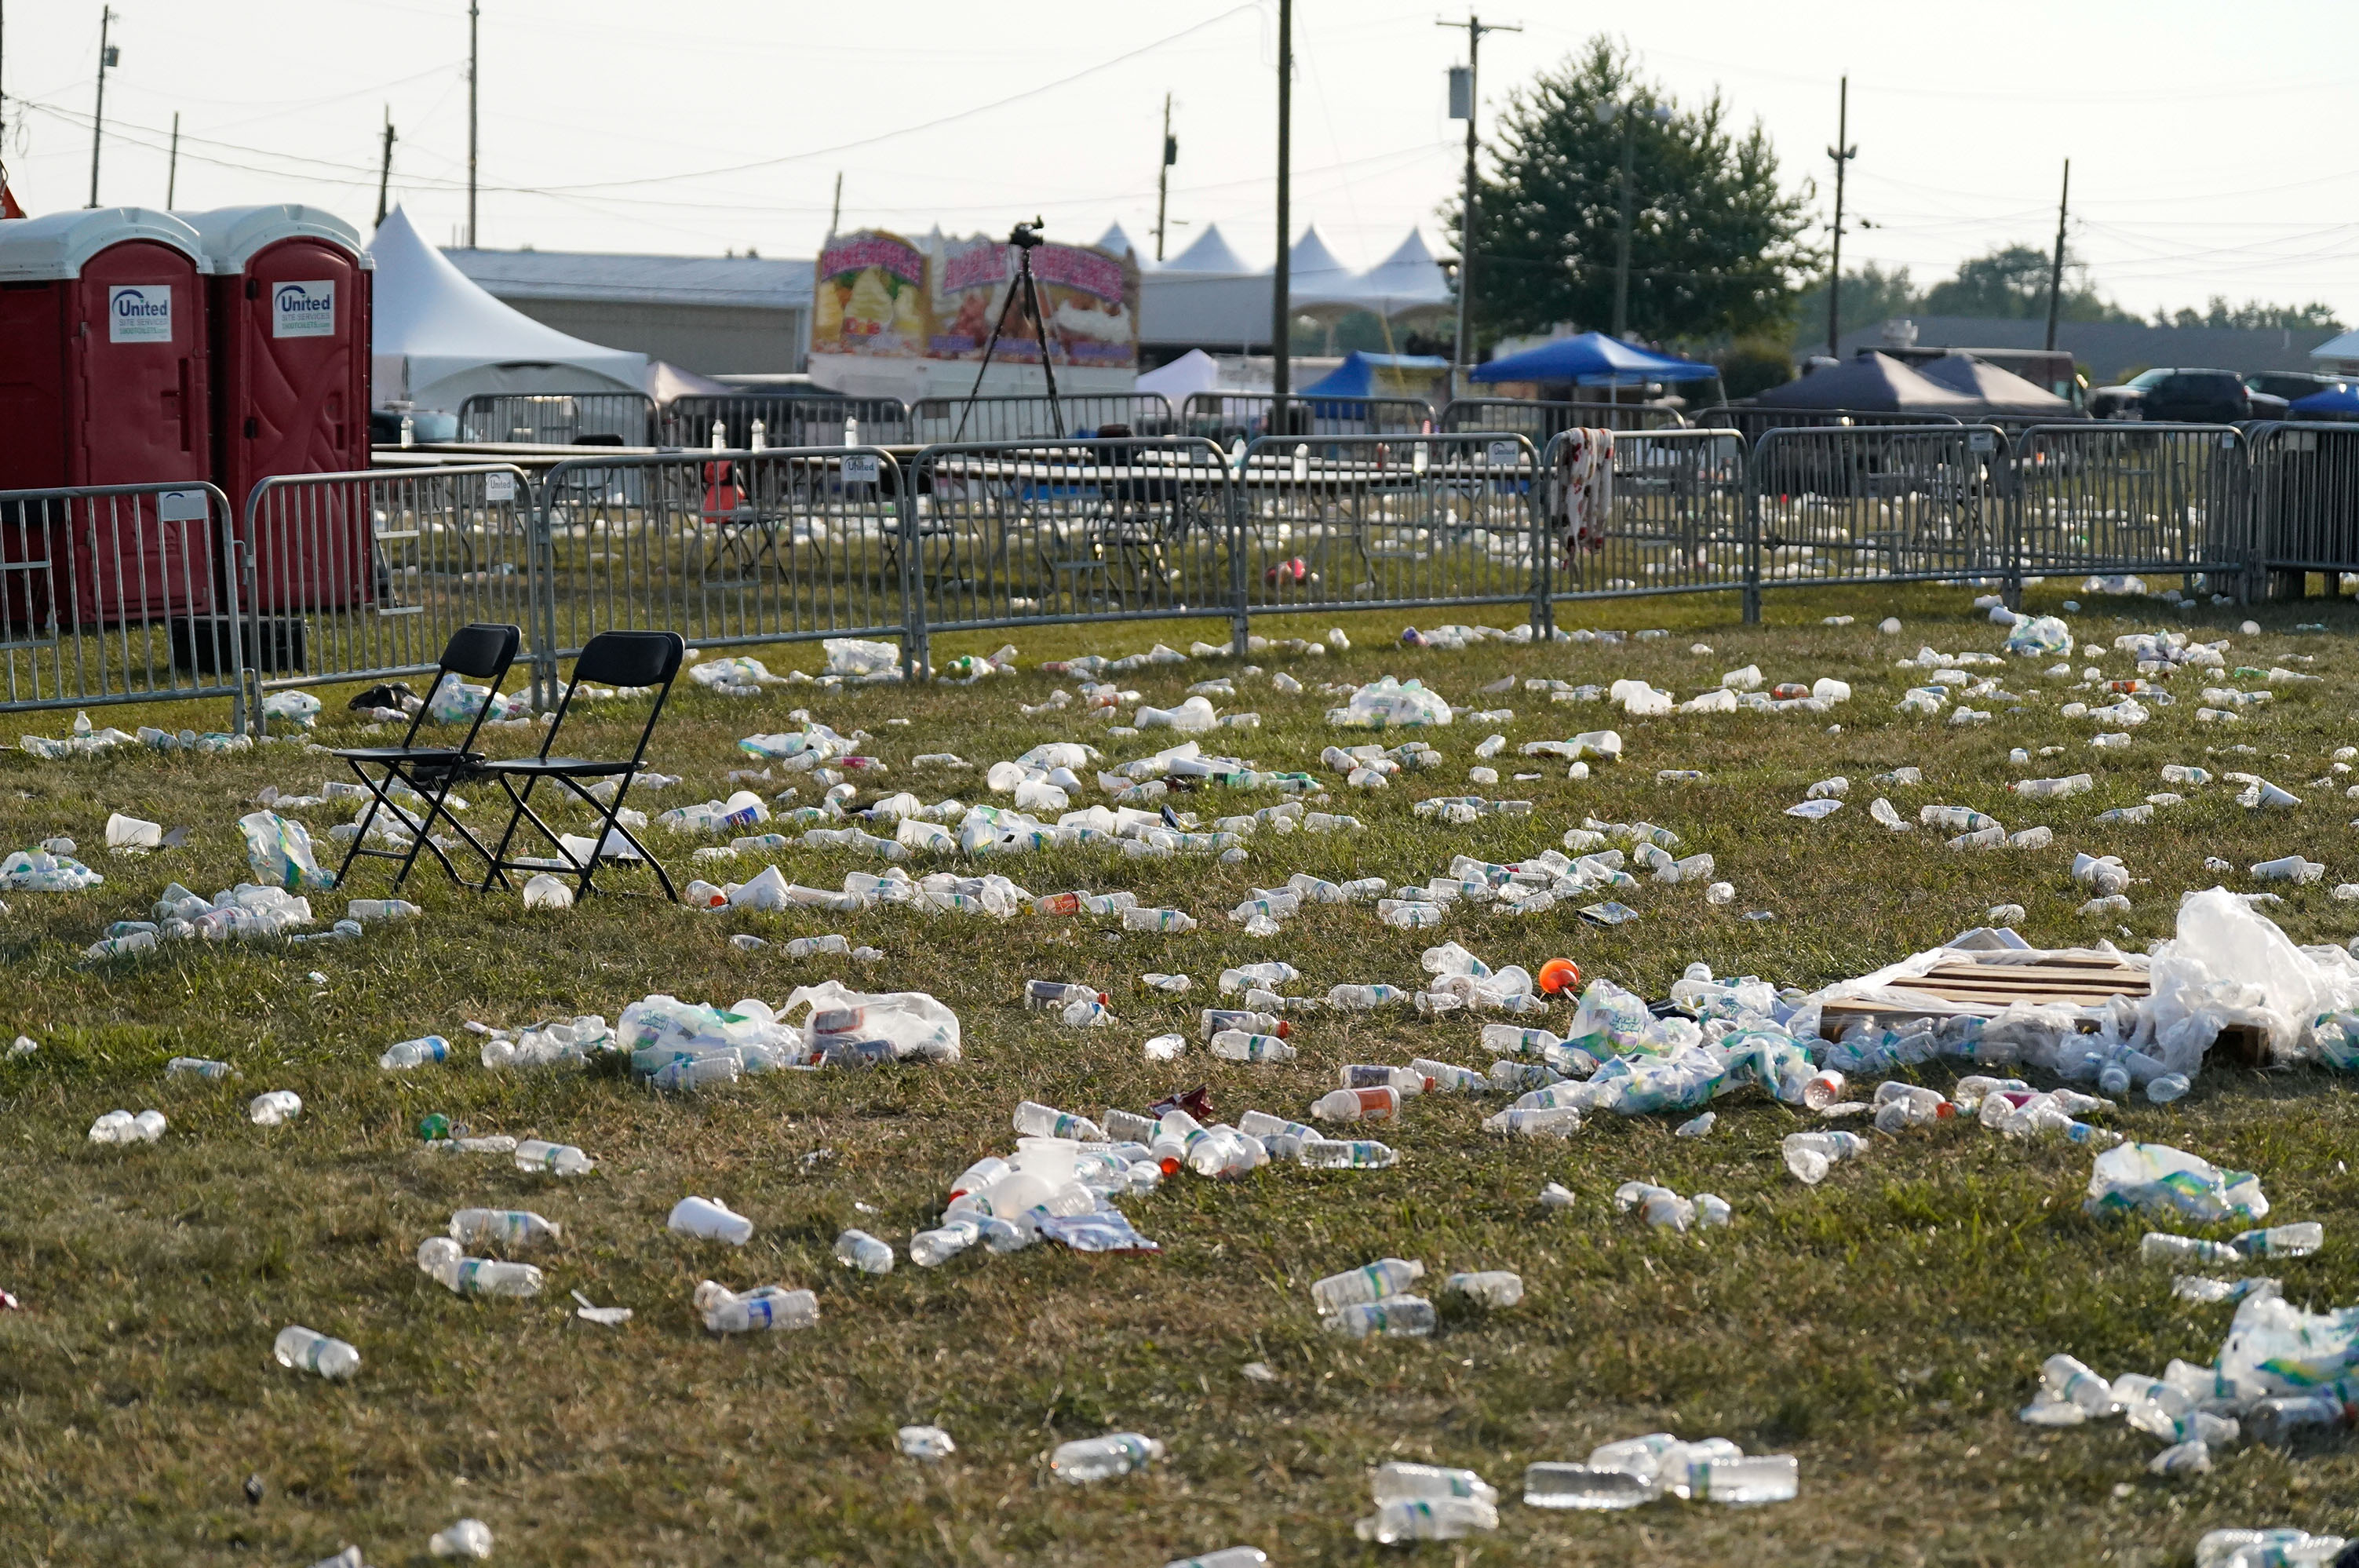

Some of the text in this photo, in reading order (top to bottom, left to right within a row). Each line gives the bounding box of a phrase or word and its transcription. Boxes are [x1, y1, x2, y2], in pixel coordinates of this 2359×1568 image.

[119, 299, 167, 316] United
[283, 294, 330, 312] United
[297, 312, 330, 321] SERVICES
[490, 480, 511, 489] United
